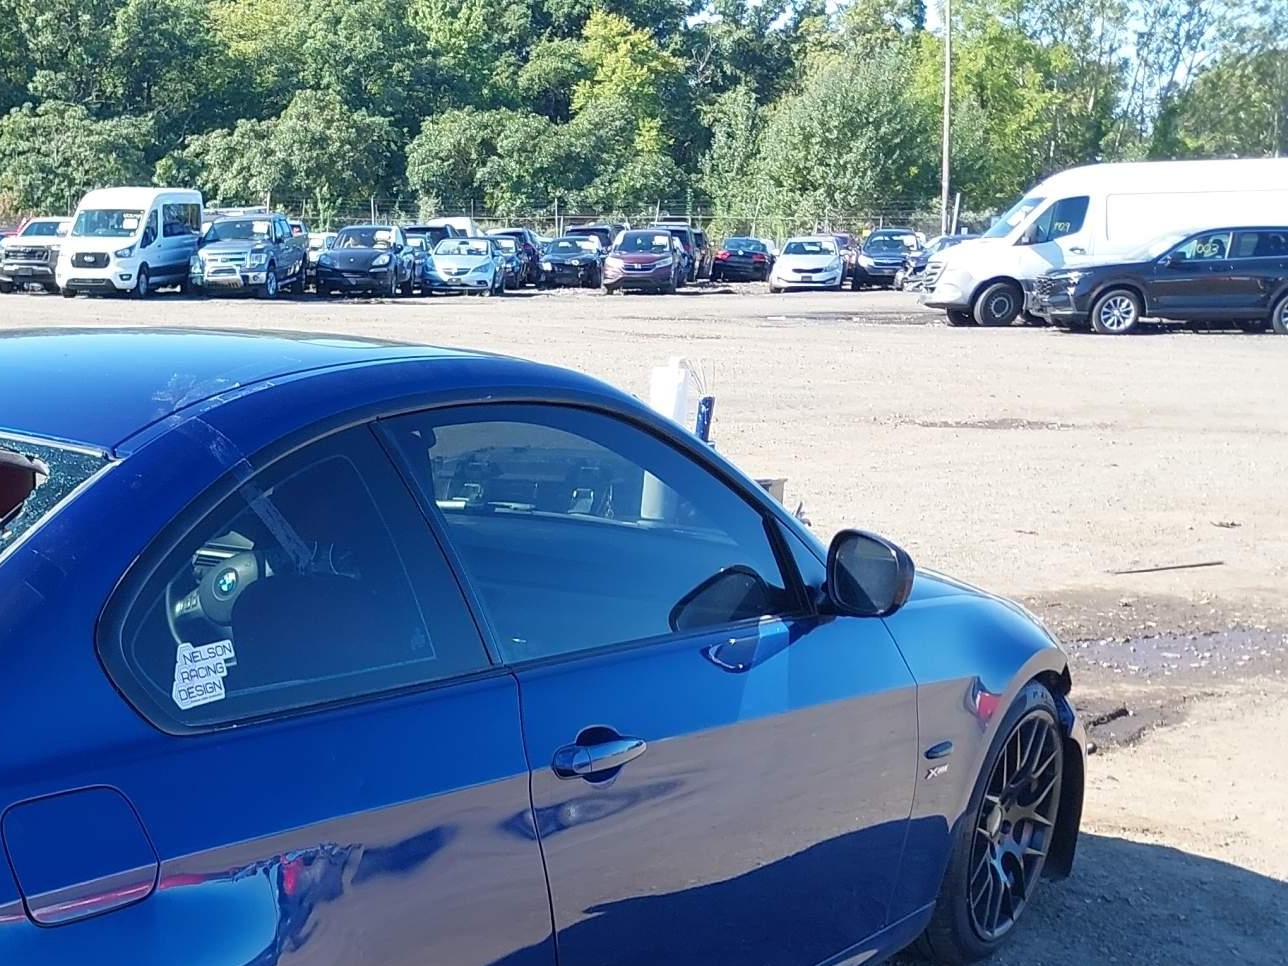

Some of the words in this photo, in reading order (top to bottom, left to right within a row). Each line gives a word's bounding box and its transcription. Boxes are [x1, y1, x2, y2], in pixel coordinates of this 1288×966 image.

[182, 643, 232, 665] NELSON
[180, 662, 225, 683] RACING
[178, 680, 223, 701] DESIGN
